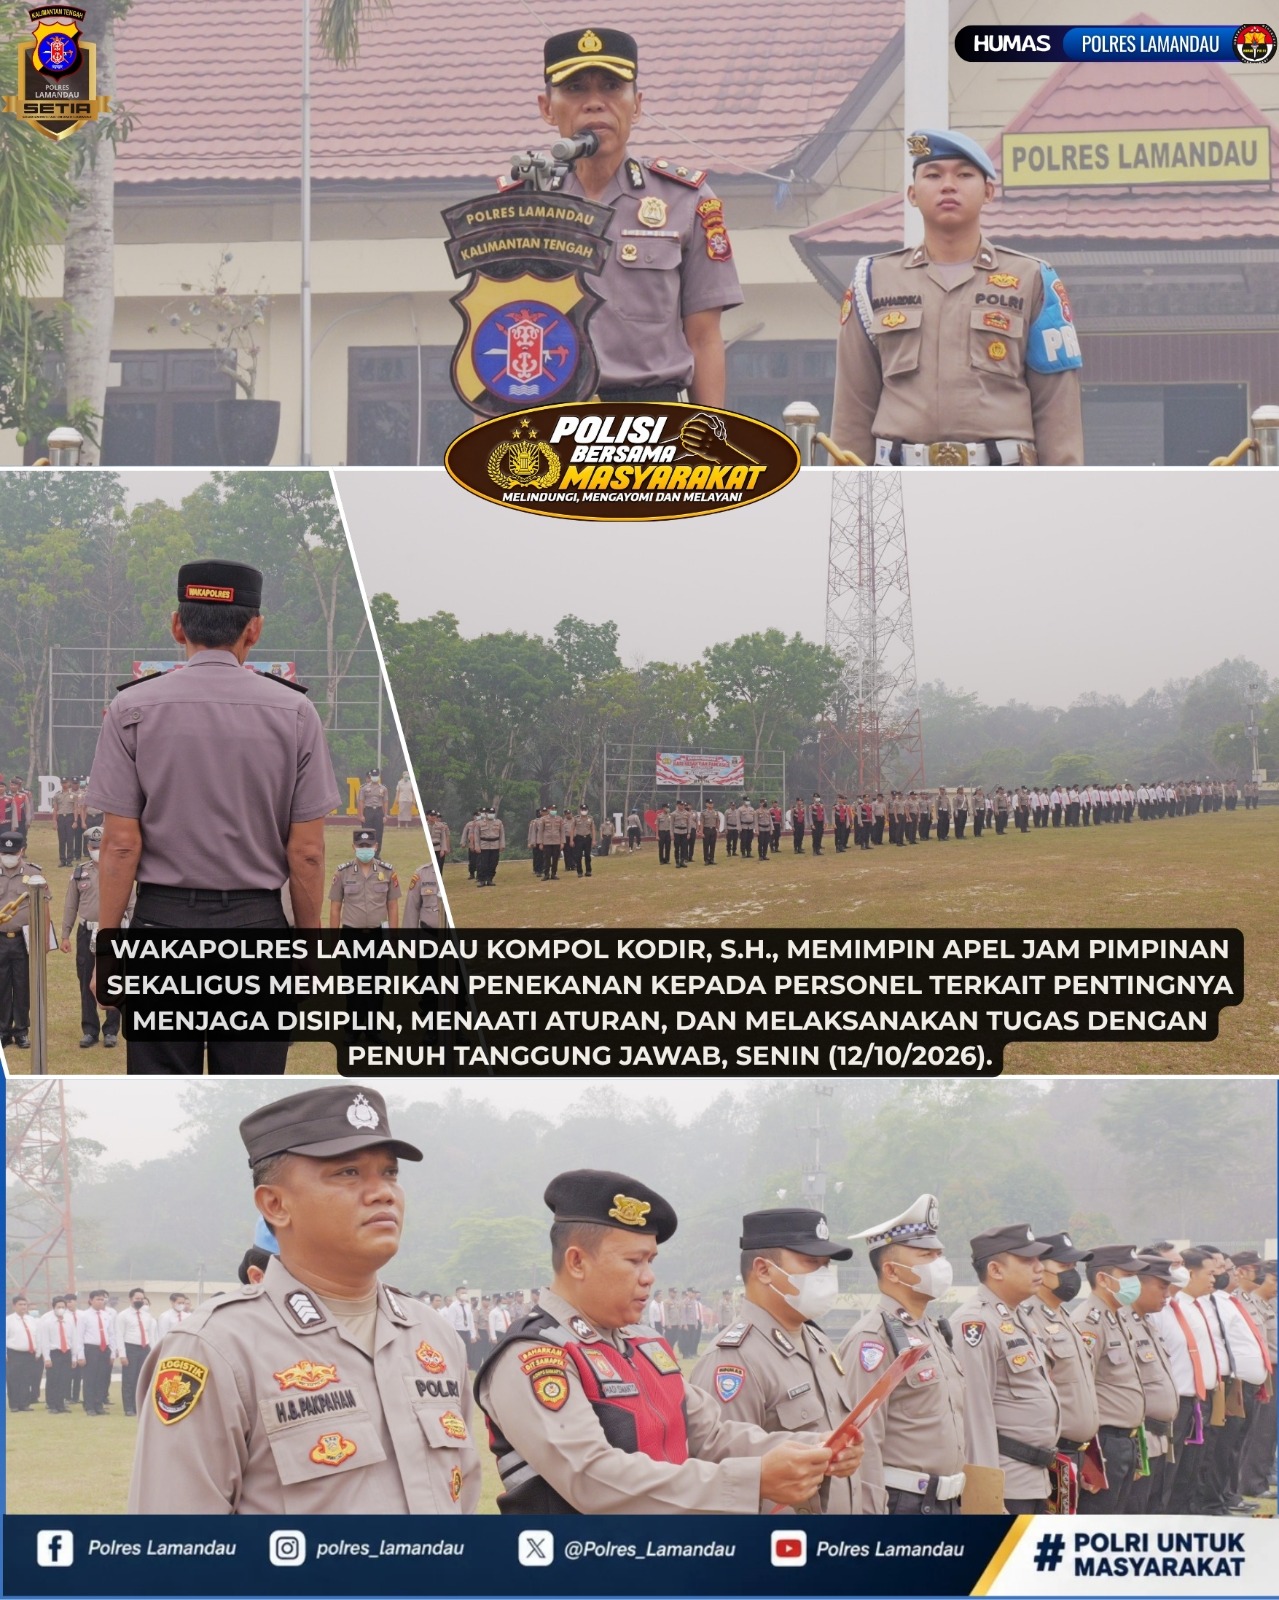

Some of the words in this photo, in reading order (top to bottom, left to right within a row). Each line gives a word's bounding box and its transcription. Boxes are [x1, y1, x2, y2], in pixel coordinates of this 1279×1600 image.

[1012, 143, 1110, 173] POLRES
[1118, 140, 1258, 169] LAMANDAU
[466, 206, 515, 225] POLRES
[518, 206, 595, 226] LAMANDAU
[460, 238, 541, 261] KALIMANTAN
[543, 238, 594, 259] TENGAH
[975, 293, 1024, 310] POLRI
[188, 587, 231, 599] WAKAPOLRES
[522, 1347, 563, 1359] BAHARKAM
[162, 1360, 204, 1377] LOGISTIK
[525, 1361, 535, 1371] DIT
[535, 1357, 564, 1367] SAMAPTA
[415, 1379, 460, 1398] POLRI
